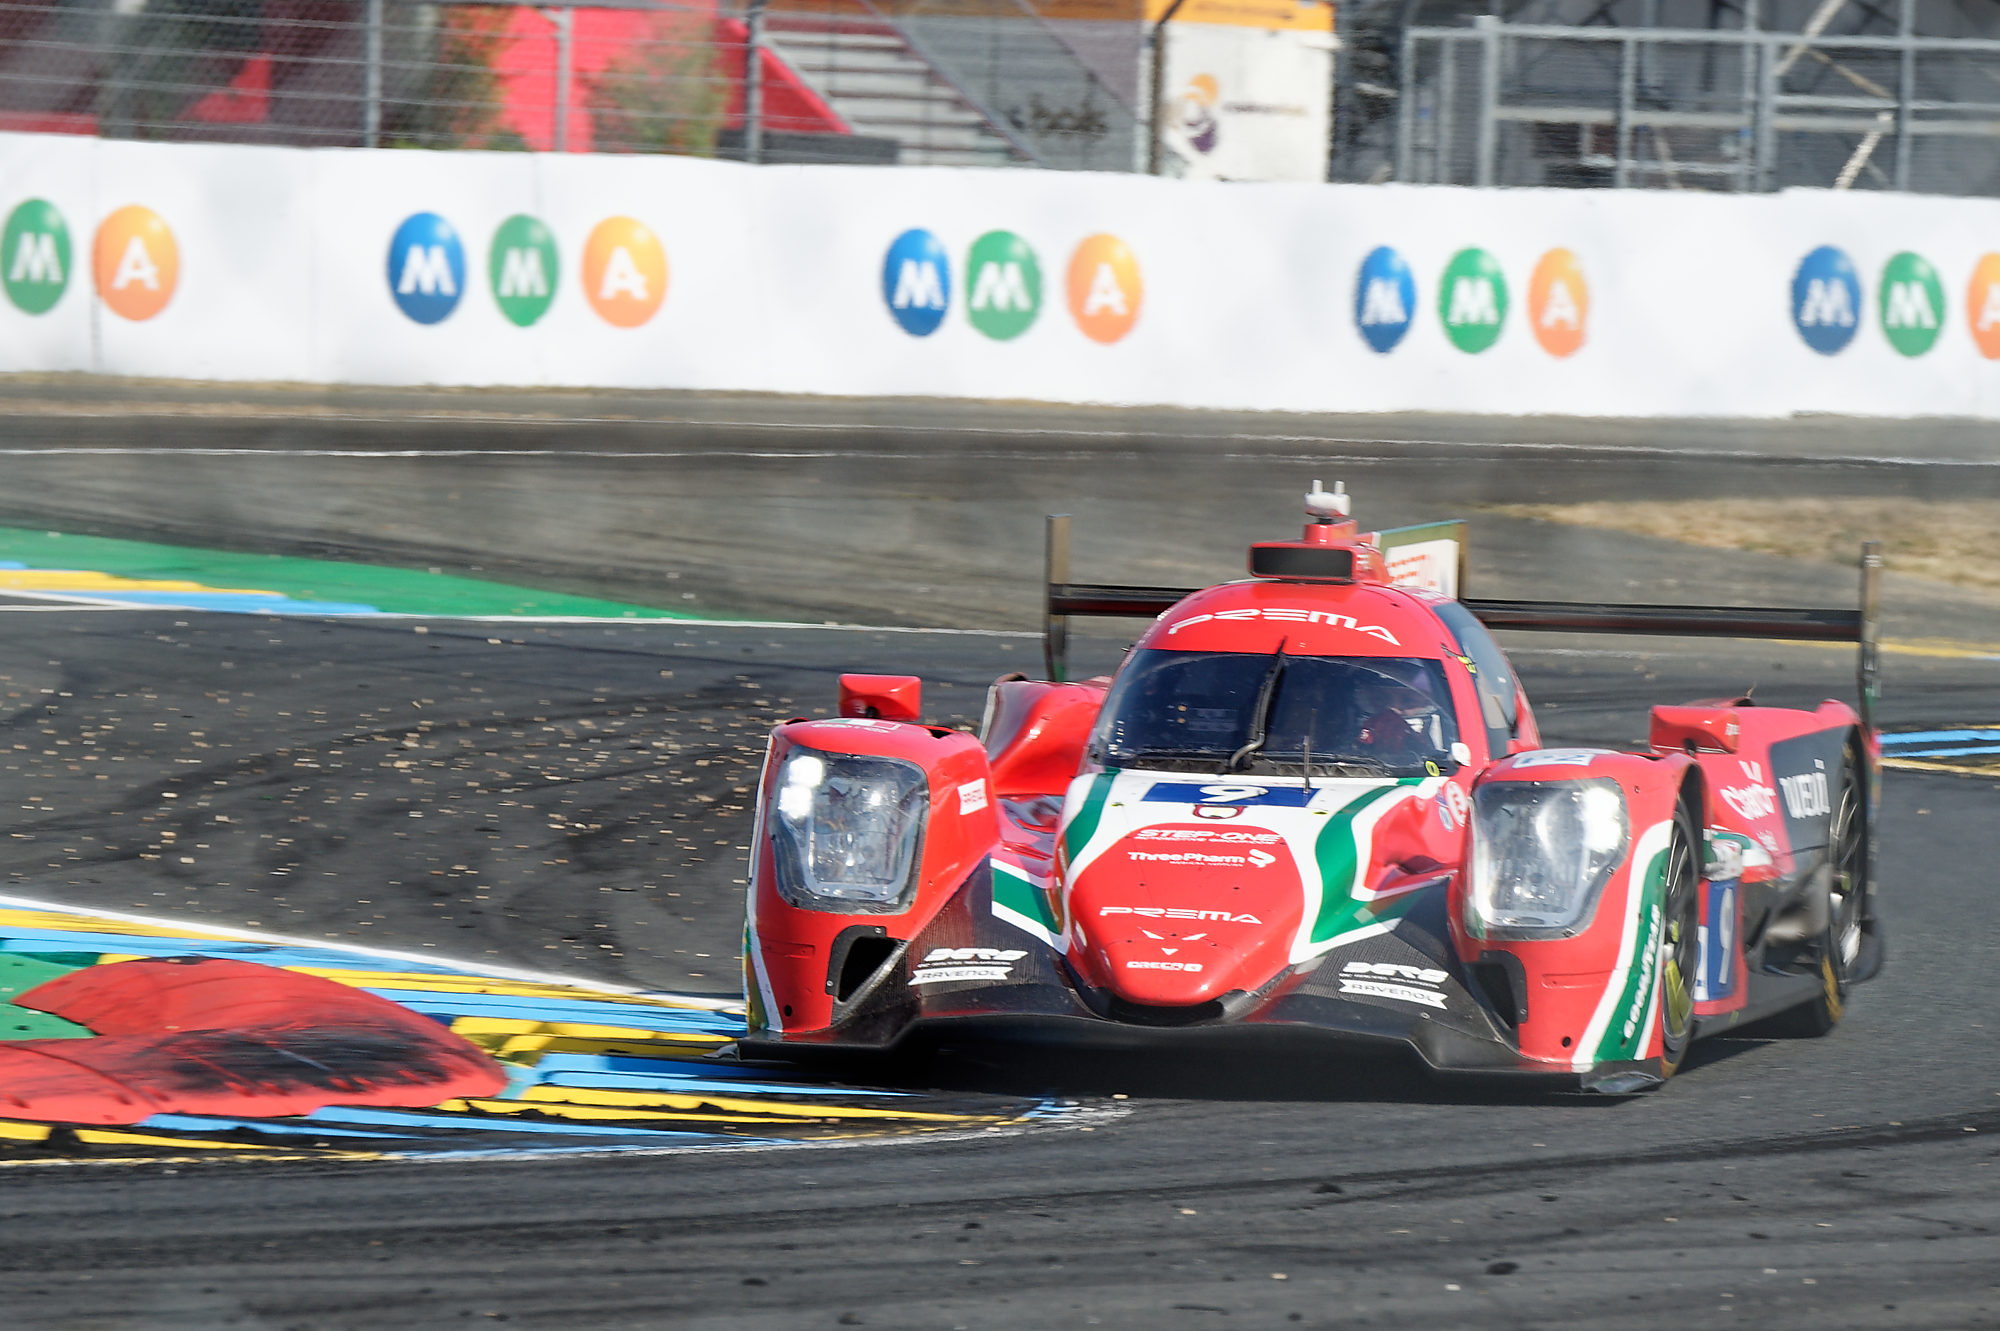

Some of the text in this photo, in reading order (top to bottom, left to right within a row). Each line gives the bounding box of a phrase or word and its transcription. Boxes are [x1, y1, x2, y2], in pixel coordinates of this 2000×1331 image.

[10, 233, 160, 290] M A
[398, 245, 649, 300] M M A
[893, 259, 1128, 317] M M A
[1446, 278, 1500, 327] M
[1800, 277, 1855, 328] M
[1886, 280, 1938, 329] M
[1168, 608, 1401, 647] PREMA
[1200, 785, 1269, 803] 9
[1128, 852, 1245, 863] ThreePharm
[1100, 907, 1263, 925] PREMA
[921, 970, 998, 979] RAVENOL
[1352, 984, 1435, 1002] RAVENOL
